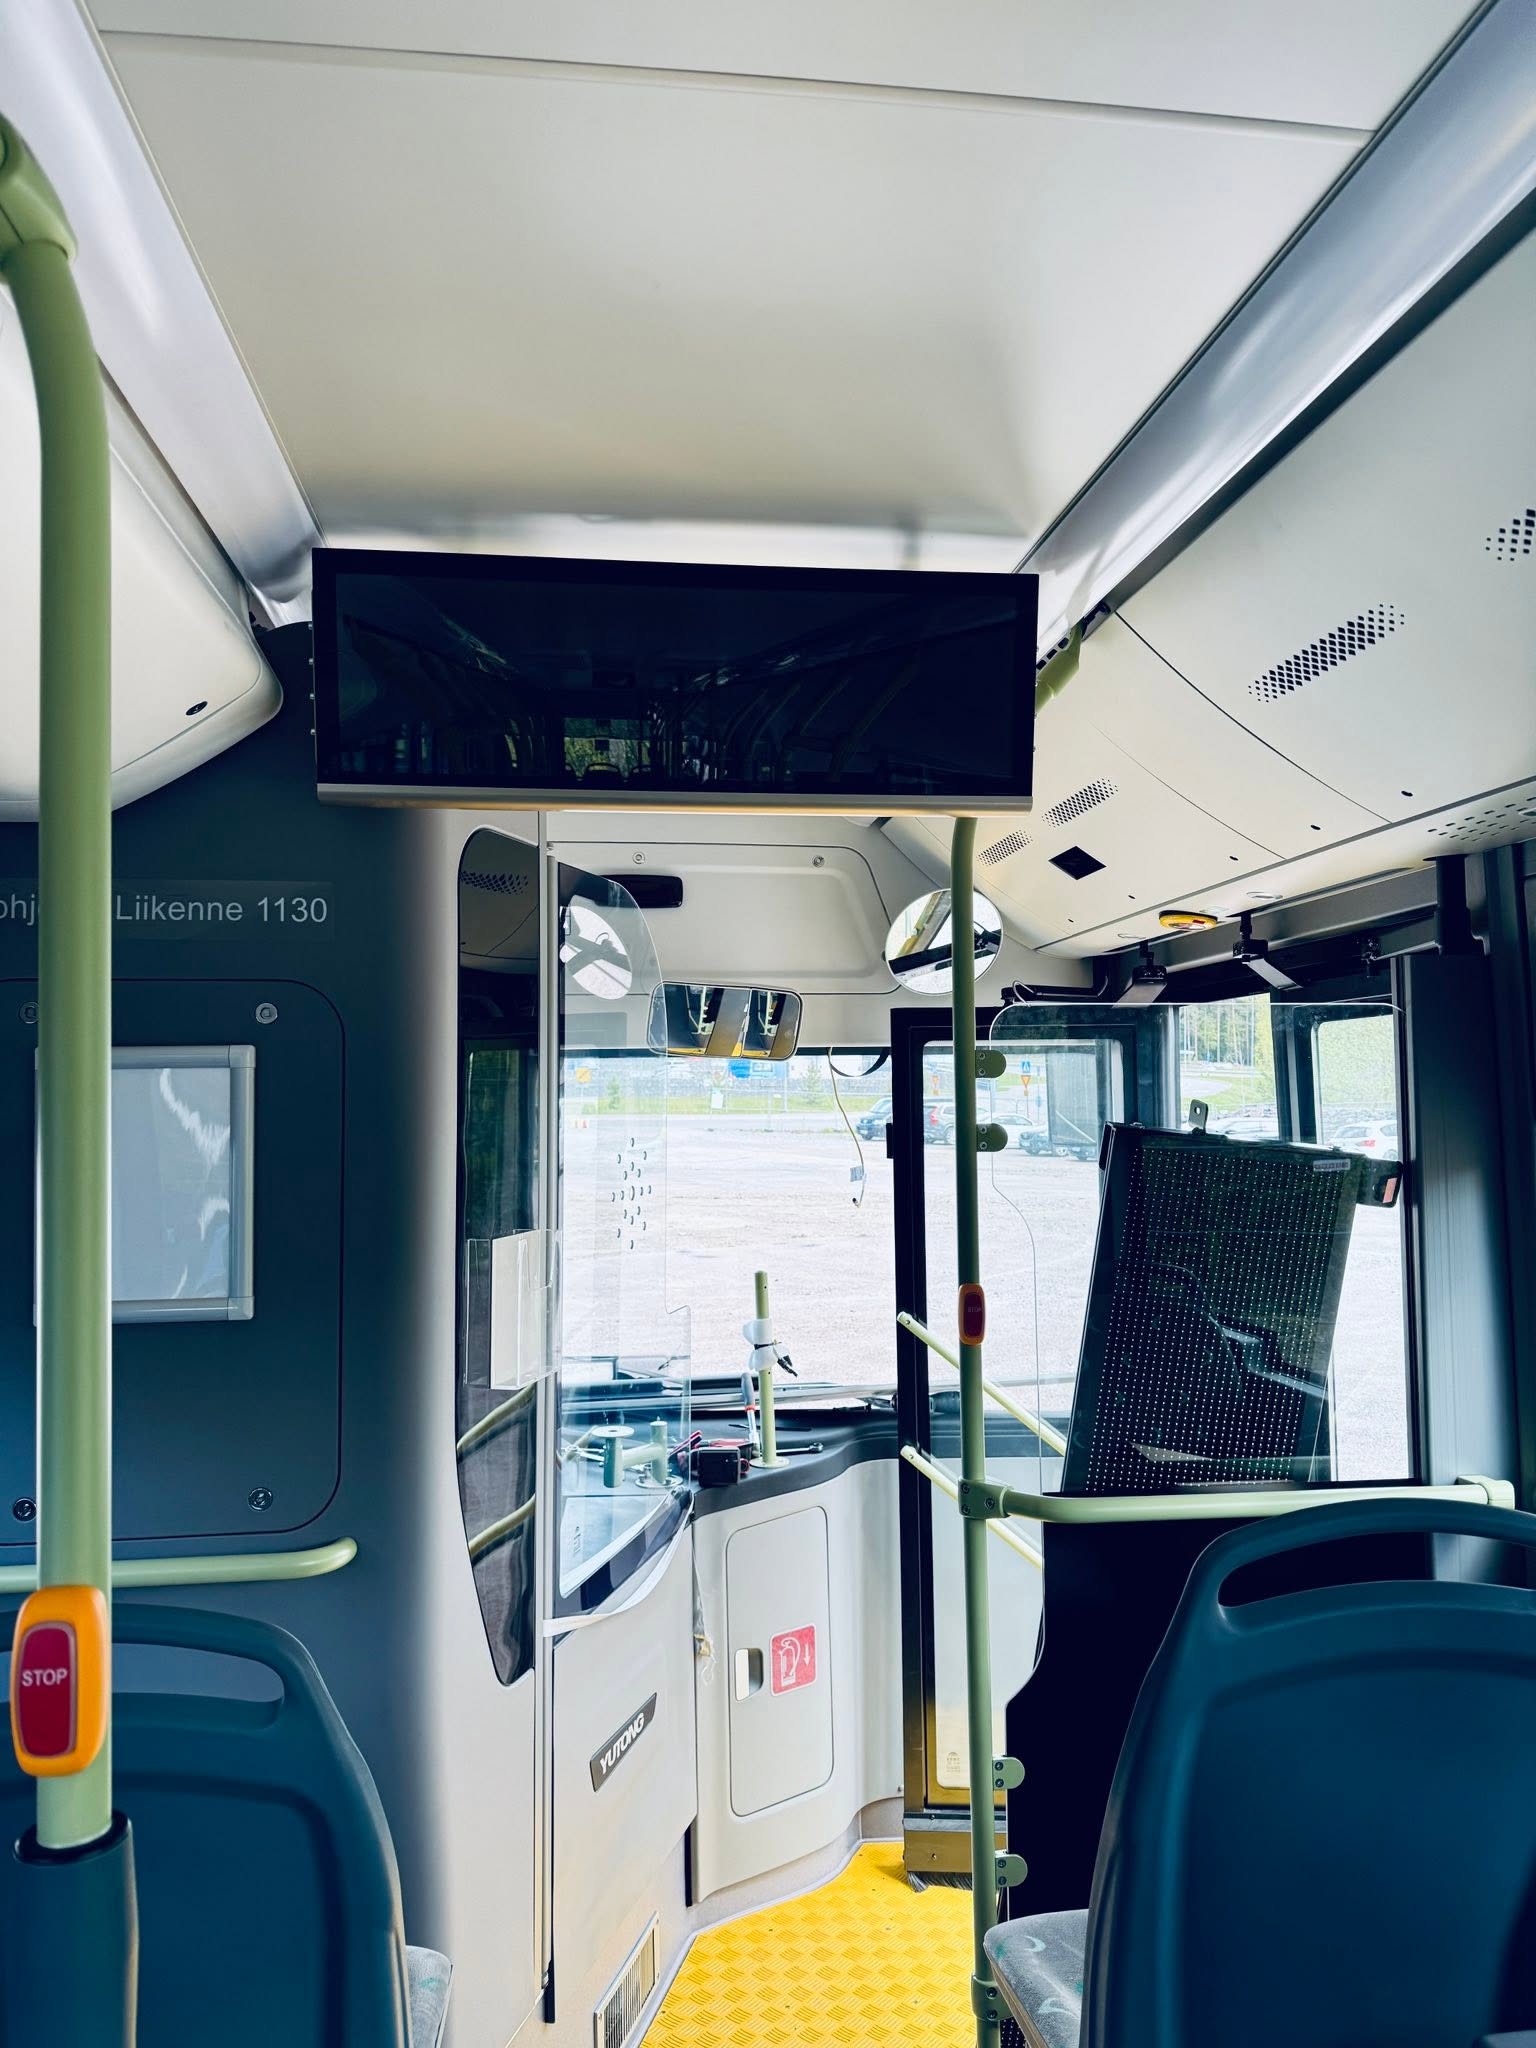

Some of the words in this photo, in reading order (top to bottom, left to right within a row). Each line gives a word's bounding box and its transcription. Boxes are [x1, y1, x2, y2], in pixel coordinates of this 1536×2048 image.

[116, 895, 243, 921] Liikenne
[257, 897, 328, 923] 1130
[22, 1667, 68, 1687] STOP
[600, 1712, 645, 1775] YUTONG
